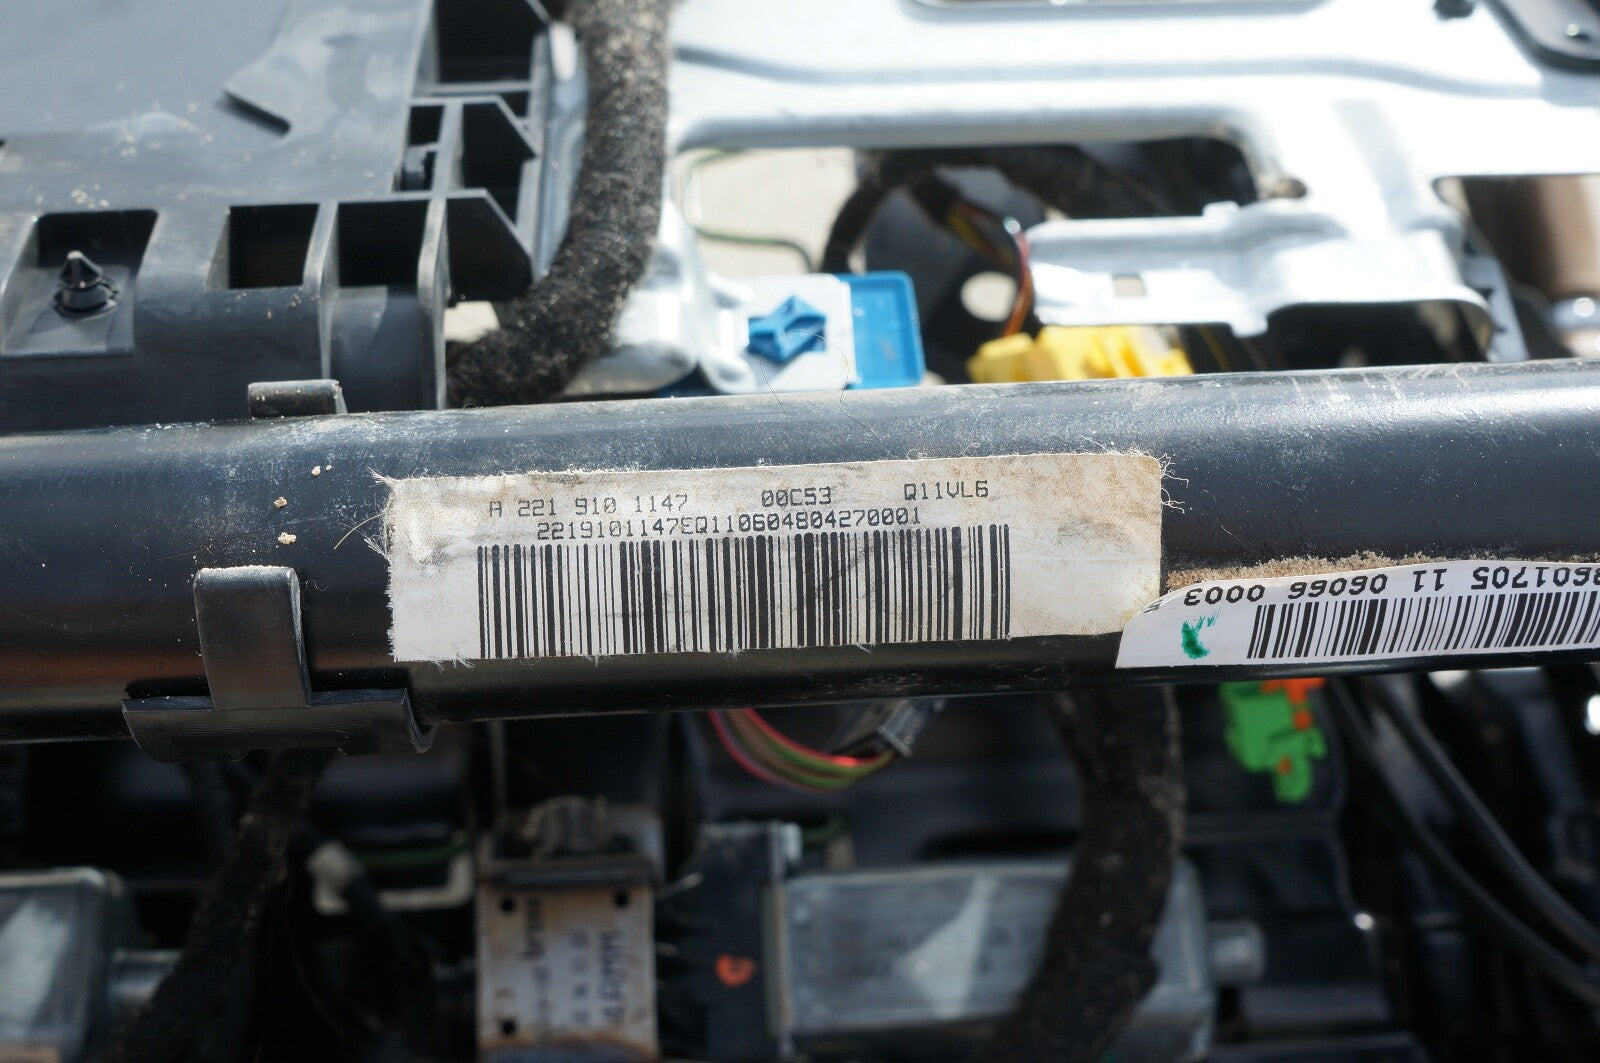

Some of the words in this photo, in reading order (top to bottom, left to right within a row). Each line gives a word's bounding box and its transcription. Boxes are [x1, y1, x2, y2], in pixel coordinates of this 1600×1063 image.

[489, 501, 503, 517] A
[518, 499, 556, 517] 221
[575, 497, 616, 516] 910
[635, 494, 688, 513] 1147
[762, 486, 832, 508] 00C53
[904, 480, 989, 501] Q11VL6
[537, 507, 921, 540] 2219101147EQ110604804270001
[1287, 573, 1389, 599] 06066
[1412, 568, 1447, 592] 11
[1183, 584, 1266, 607] 0003
